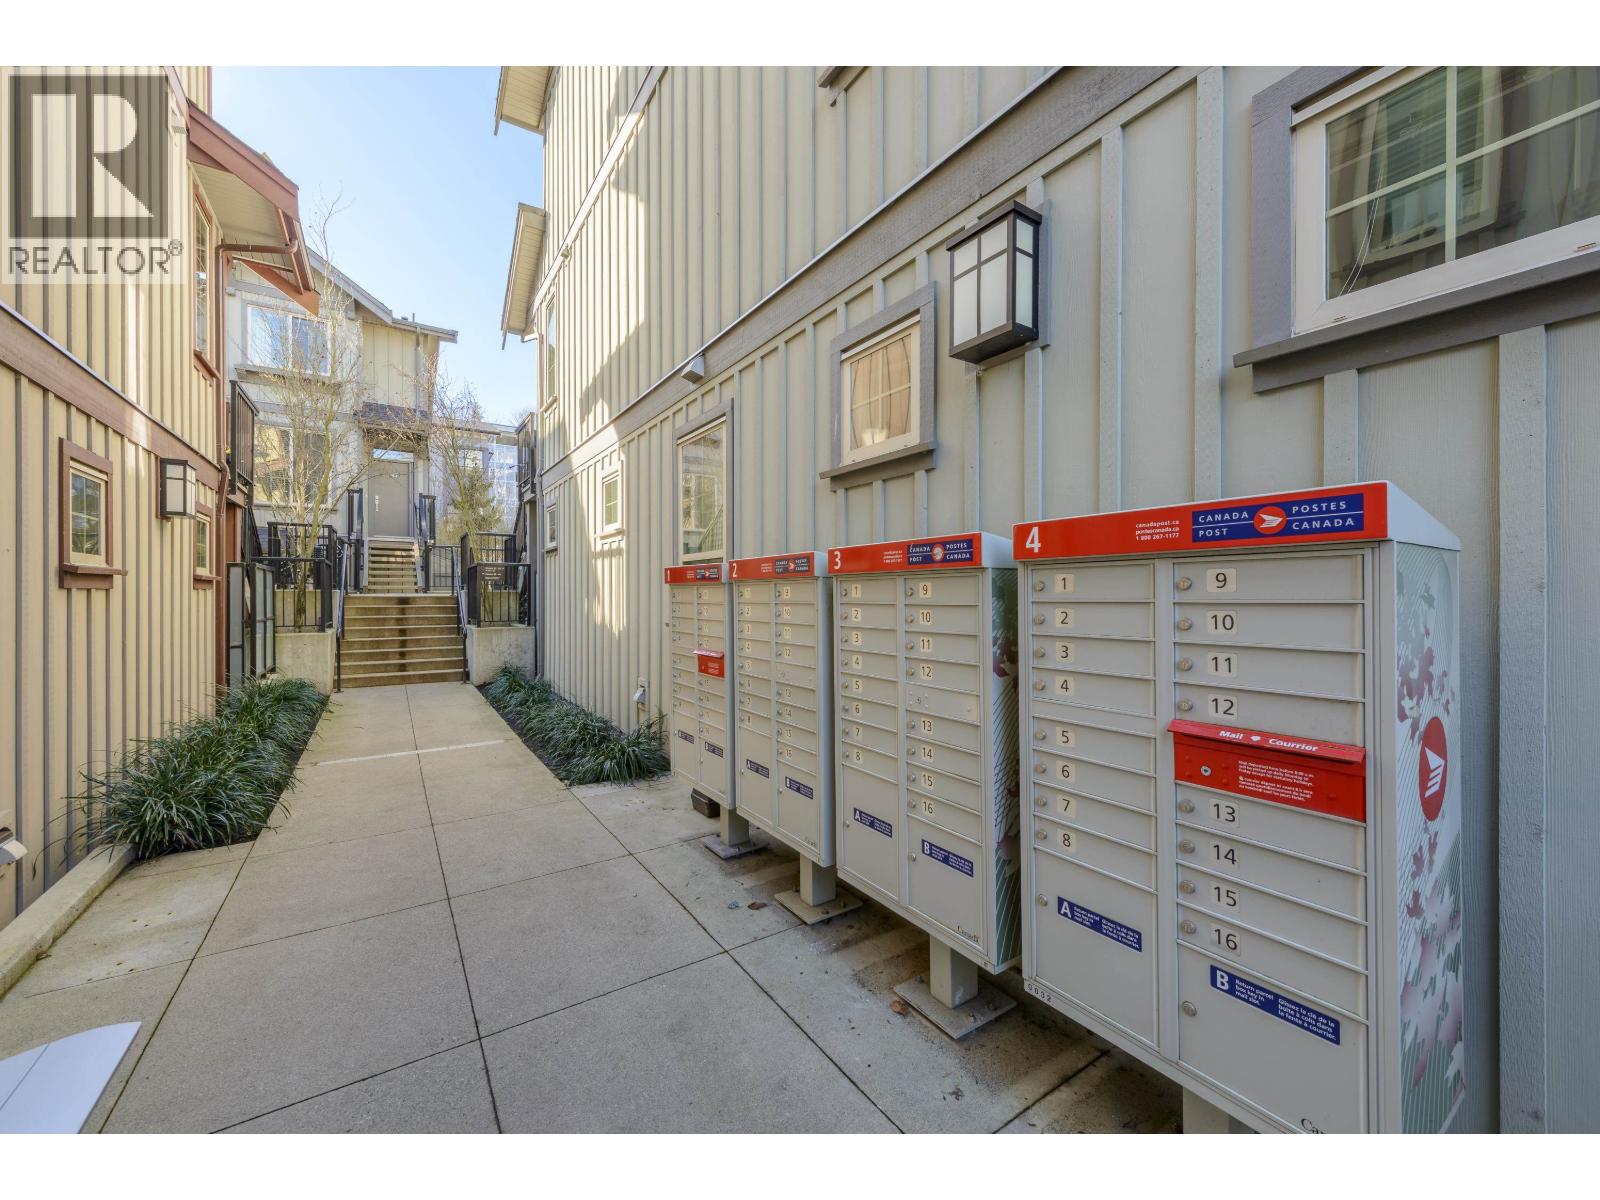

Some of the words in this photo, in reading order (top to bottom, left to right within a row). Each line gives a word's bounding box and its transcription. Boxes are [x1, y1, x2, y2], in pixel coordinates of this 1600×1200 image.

[1292, 500, 1347, 514] POSTES
[1198, 510, 1249, 523] CANADA
[1292, 517, 1355, 531] CANADA
[1025, 527, 1041, 553] 4
[1199, 528, 1228, 538] POST
[946, 542, 968, 550] POSTES
[834, 550, 842, 570] 3
[946, 552, 970, 560] CANADA
[732, 563, 737, 578] 2
[1061, 576, 1067, 590] 1
[1215, 572, 1228, 589] 9
[921, 612, 931, 622] 10
[1060, 611, 1069, 625] 2
[1211, 614, 1235, 631] 10
[921, 638, 930, 650] 11
[1060, 645, 1069, 659] 3
[922, 666, 932, 678] 12
[1211, 656, 1234, 674] 11
[1060, 679, 1070, 693] 4
[1211, 698, 1235, 716] 12
[922, 720, 932, 732] 13
[1061, 730, 1070, 744] 5
[1220, 730, 1244, 740] Mail
[922, 748, 933, 760] 14
[1061, 764, 1070, 779] 6
[923, 774, 933, 787] 15
[923, 801, 934, 814] 16
[1062, 798, 1071, 812] 7
[1213, 802, 1236, 822] 13
[854, 810, 861, 822] A
[1062, 833, 1071, 848] 8
[924, 841, 930, 855] B
[1213, 844, 1237, 865] 14
[1213, 886, 1237, 907] 15
[1060, 900, 1072, 918] A
[1213, 928, 1238, 951] 16
[1216, 969, 1229, 990] B
